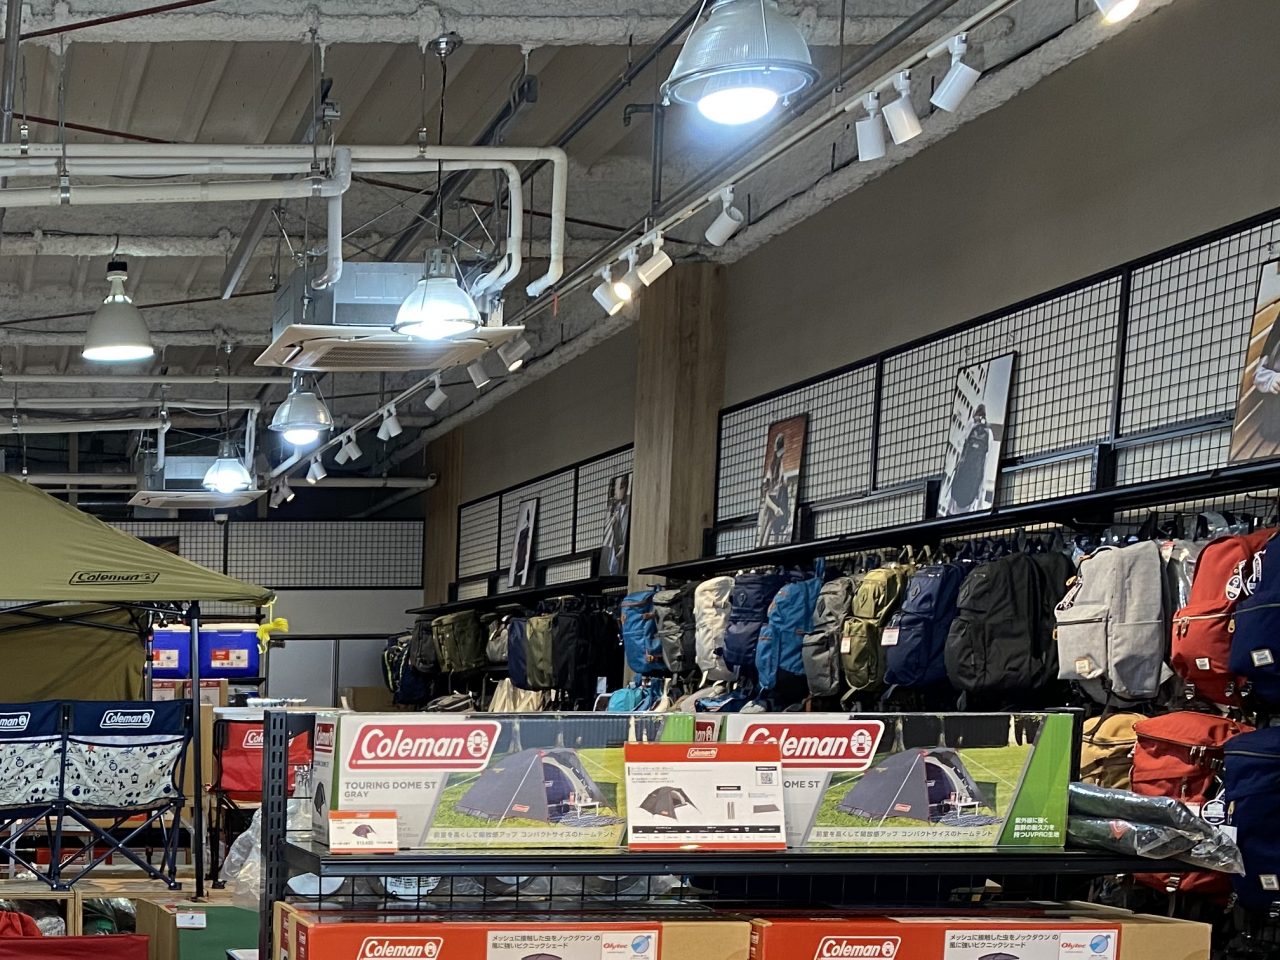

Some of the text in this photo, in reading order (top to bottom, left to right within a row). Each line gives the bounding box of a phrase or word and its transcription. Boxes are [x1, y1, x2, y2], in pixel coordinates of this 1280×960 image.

[105, 712, 142, 724] Coleman
[361, 727, 466, 760] Coleman
[747, 727, 848, 757] Cleman
[345, 781, 437, 790] TOURING DOME ST
[784, 780, 821, 788] OME ST
[344, 790, 369, 799] GRAY
[365, 940, 424, 958] Coleman
[823, 940, 881, 958] Coleman
